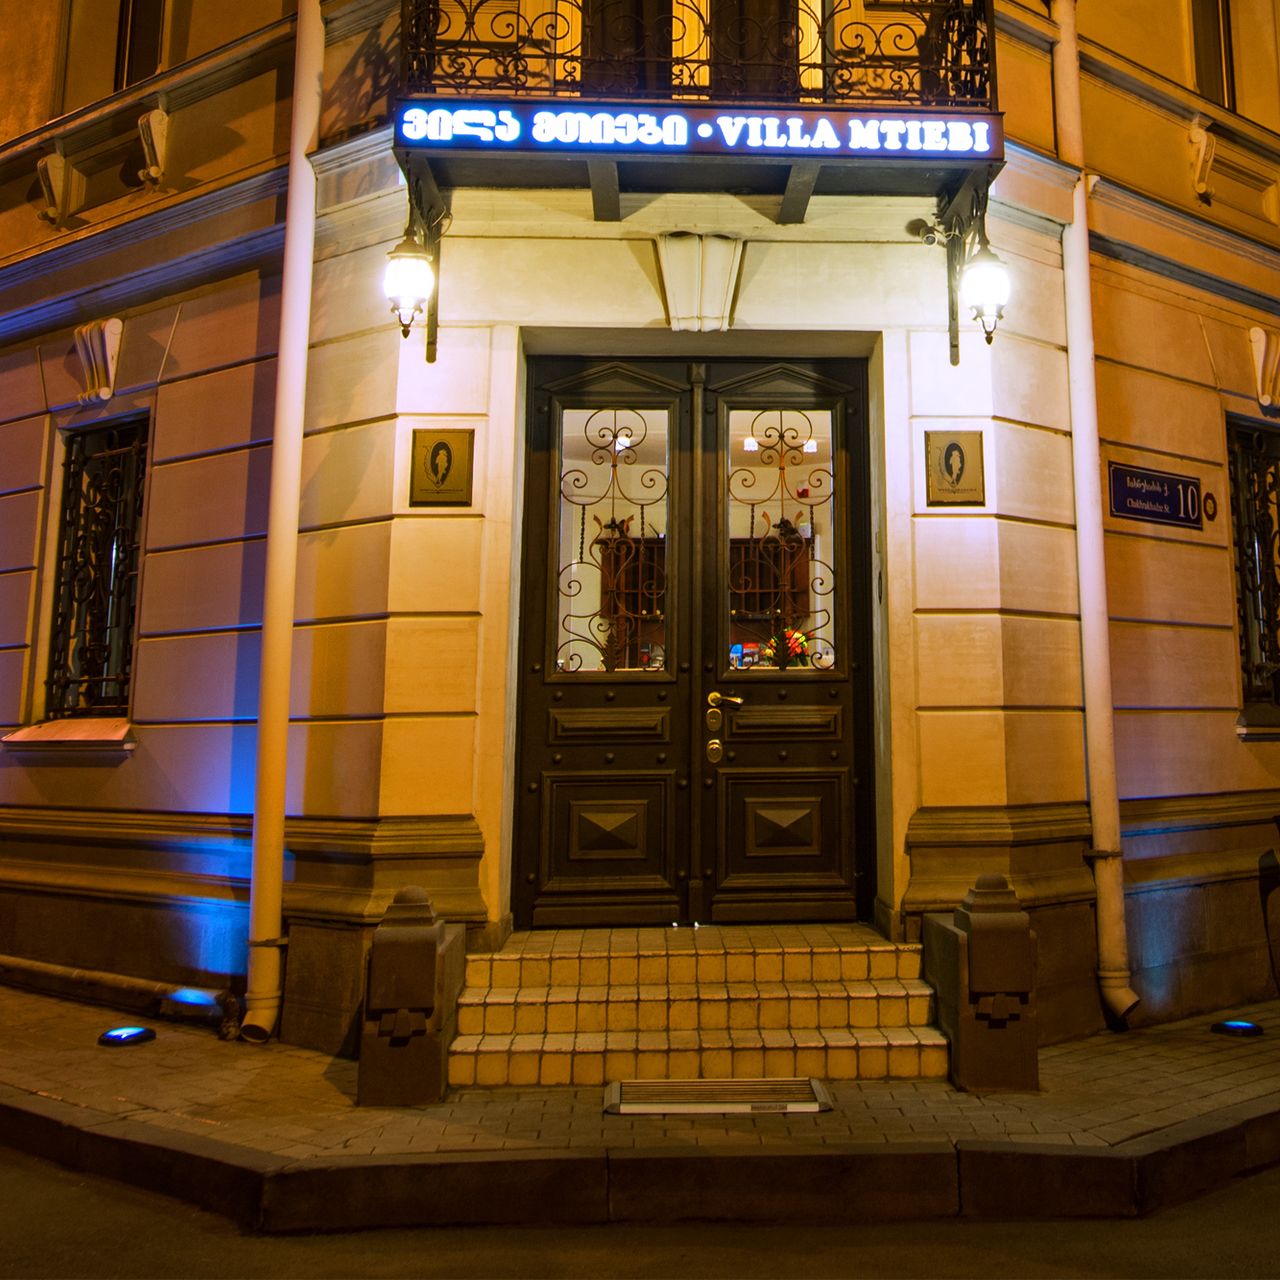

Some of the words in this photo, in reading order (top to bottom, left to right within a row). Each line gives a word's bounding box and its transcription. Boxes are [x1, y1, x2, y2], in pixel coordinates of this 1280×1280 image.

[402, 108, 521, 142] ვილა
[531, 111, 688, 145] მთიები
[716, 116, 841, 148] VILLA
[847, 119, 991, 152] MTIEBI
[1177, 483, 1199, 520] 10
